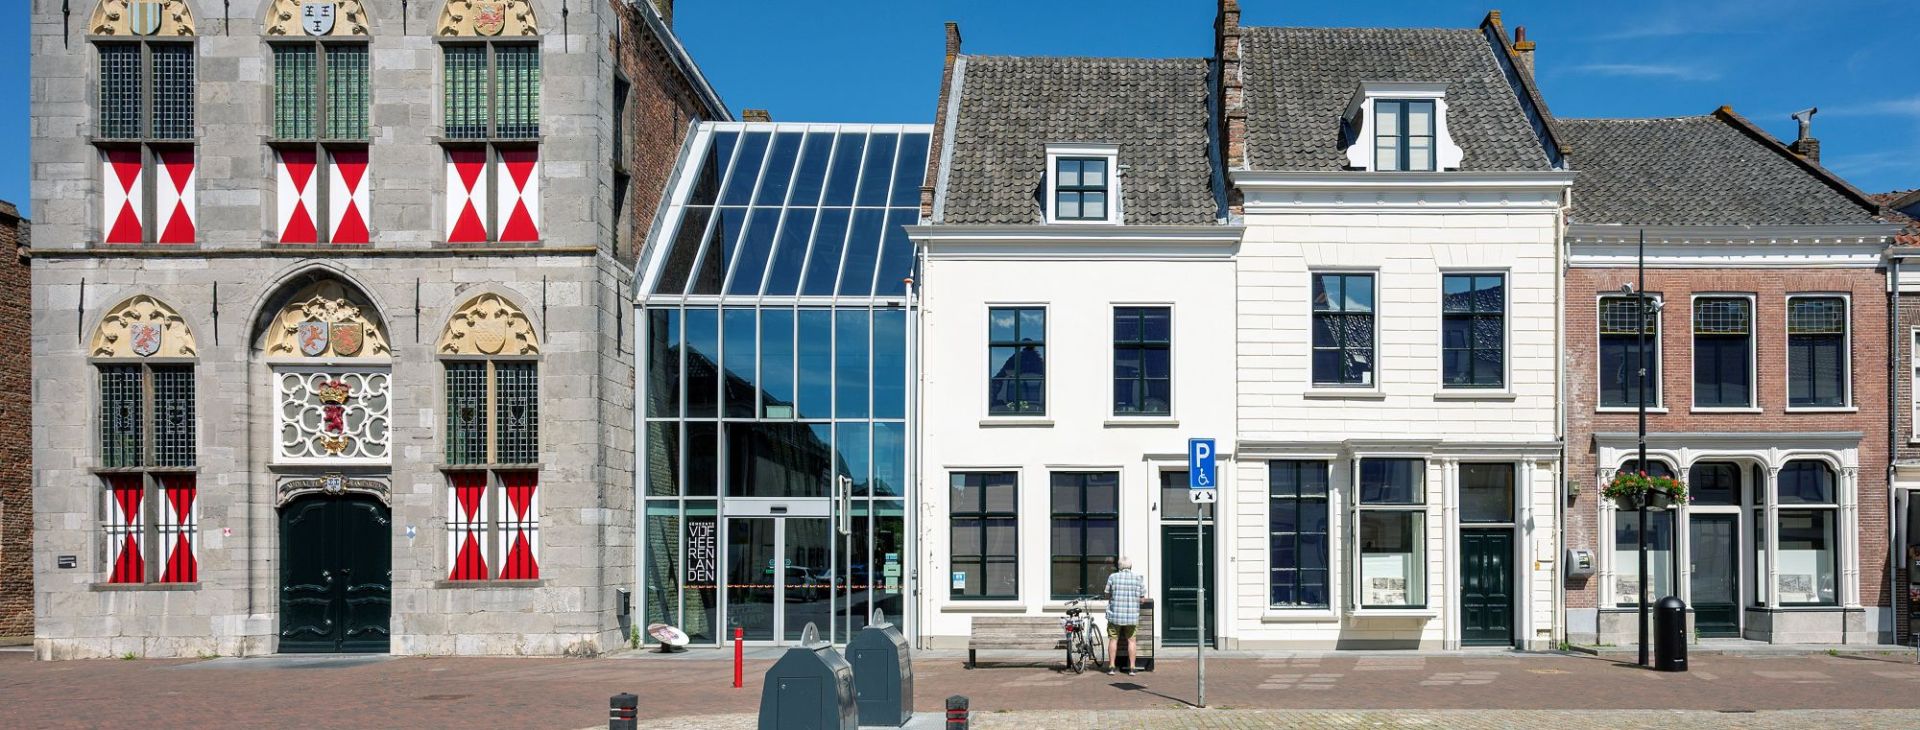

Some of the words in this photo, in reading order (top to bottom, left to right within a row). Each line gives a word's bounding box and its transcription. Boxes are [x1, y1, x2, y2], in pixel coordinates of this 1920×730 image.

[1196, 442, 1210, 468] P
[688, 526, 715, 537] VIJF
[688, 537, 715, 548] HEE
[688, 548, 714, 559] REN
[688, 559, 714, 571] LAN
[688, 571, 714, 582] DEN
